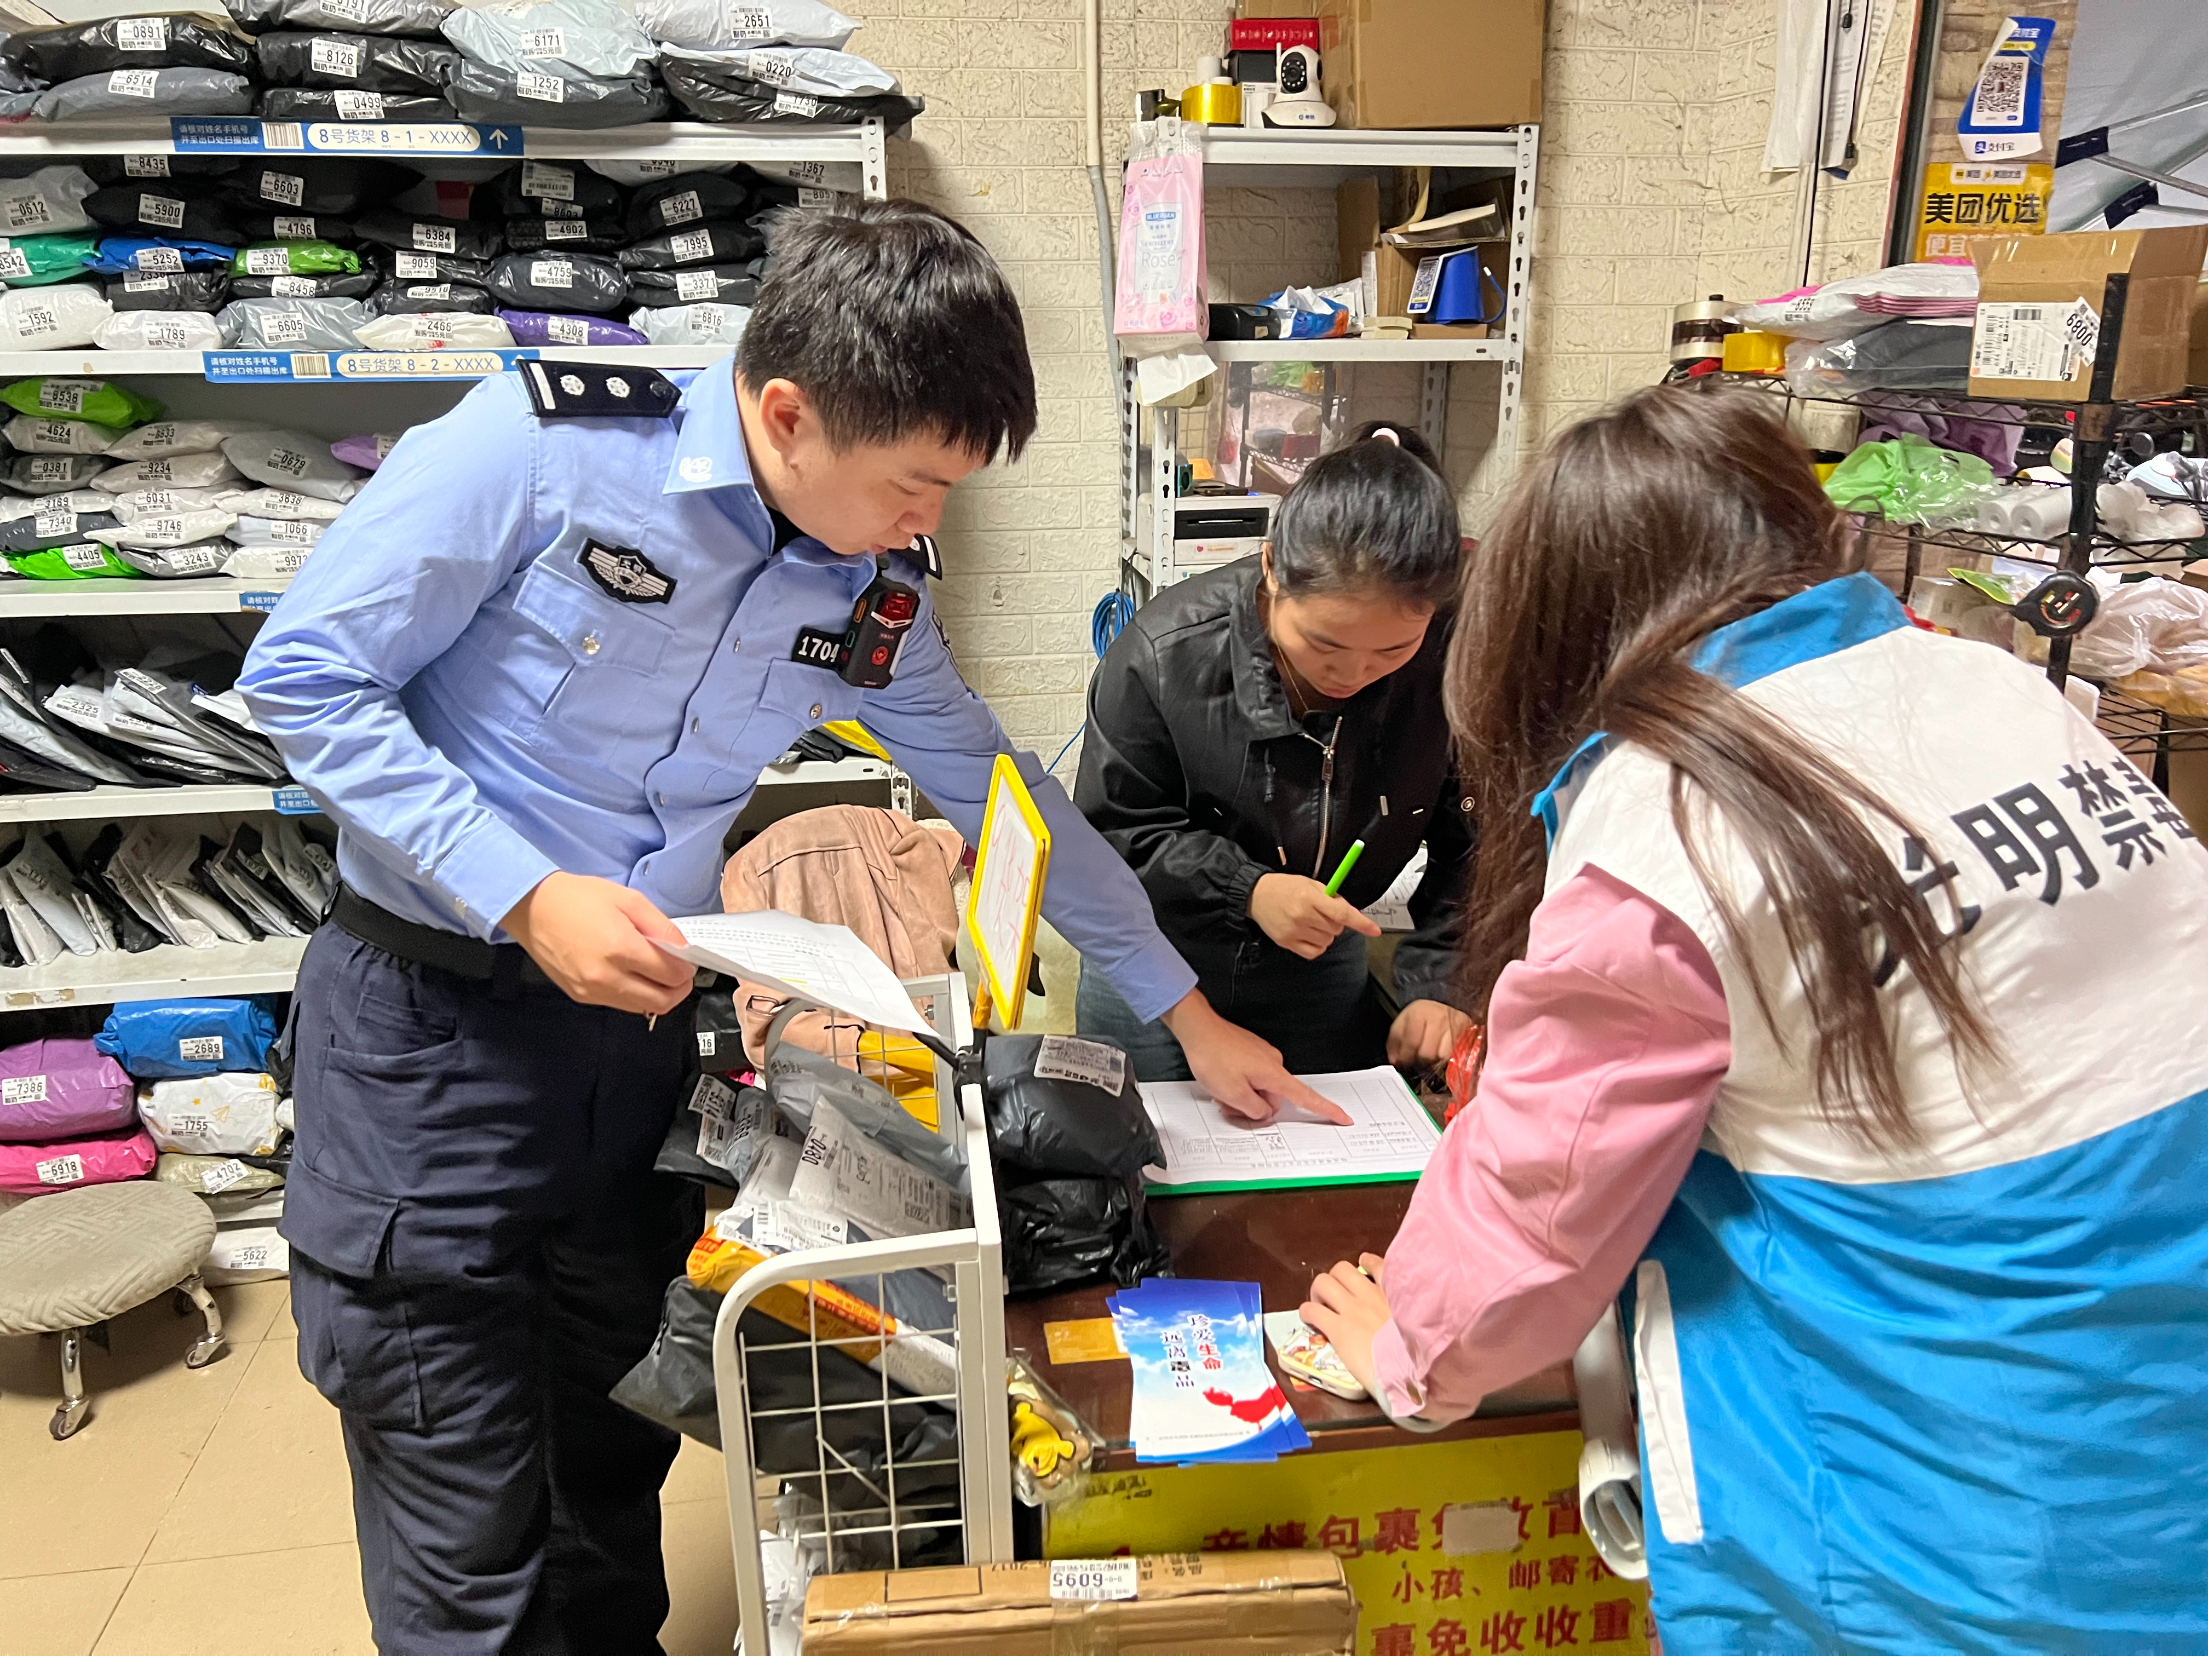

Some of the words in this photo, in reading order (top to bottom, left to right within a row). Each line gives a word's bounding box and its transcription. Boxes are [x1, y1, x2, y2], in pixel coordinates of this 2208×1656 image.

[744, 15, 770, 28] 2651
[133, 23, 162, 39] 0891
[534, 35, 561, 47] 6171
[326, 50, 354, 65] 8126
[766, 61, 791, 78] 0220
[126, 74, 152, 86] 6514
[533, 76, 560, 90] 1252
[353, 97, 381, 109] 0499
[1987, 142, 2015, 153] 支付宝
[139, 158, 166, 170] 8435
[273, 180, 299, 195] 6603
[19, 201, 46, 216] 0612
[154, 203, 180, 218] 5900
[672, 199, 697, 213] 6227
[1925, 193, 2041, 224] 美团优选
[287, 223, 312, 235] 4796
[560, 225, 584, 235] 4902
[425, 230, 451, 242] 6384
[684, 236, 708, 250] 7995
[153, 254, 179, 266] 5252
[262, 254, 288, 265] 9370
[411, 258, 435, 269] 9059
[1142, 252, 1176, 268] Rose
[547, 267, 572, 278] 4759
[289, 282, 315, 297] 8458
[28, 311, 56, 326] 1592
[702, 314, 724, 326] 6816
[278, 321, 303, 332] 6605
[427, 321, 452, 331] 2466
[559, 325, 584, 338] 4308
[159, 328, 185, 339] 1789
[52, 390, 79, 403] 8538
[47, 426, 71, 438] 4624
[42, 462, 67, 473] 0381
[148, 462, 171, 473] 9234
[281, 453, 306, 470] 0679
[146, 492, 171, 503] 6031
[278, 493, 303, 505] 3838
[49, 517, 72, 528] 7340
[157, 521, 182, 531] 9746
[284, 523, 307, 535] 1066
[77, 550, 100, 562] 4405
[183, 552, 209, 566] 3243
[195, 1043, 220, 1054] 2689
[17, 1081, 43, 1094] 7386
[184, 1121, 208, 1131] 1755
[51, 1161, 77, 1174] 6918
[216, 1162, 241, 1181] 4702
[243, 1250, 268, 1260] 5622
